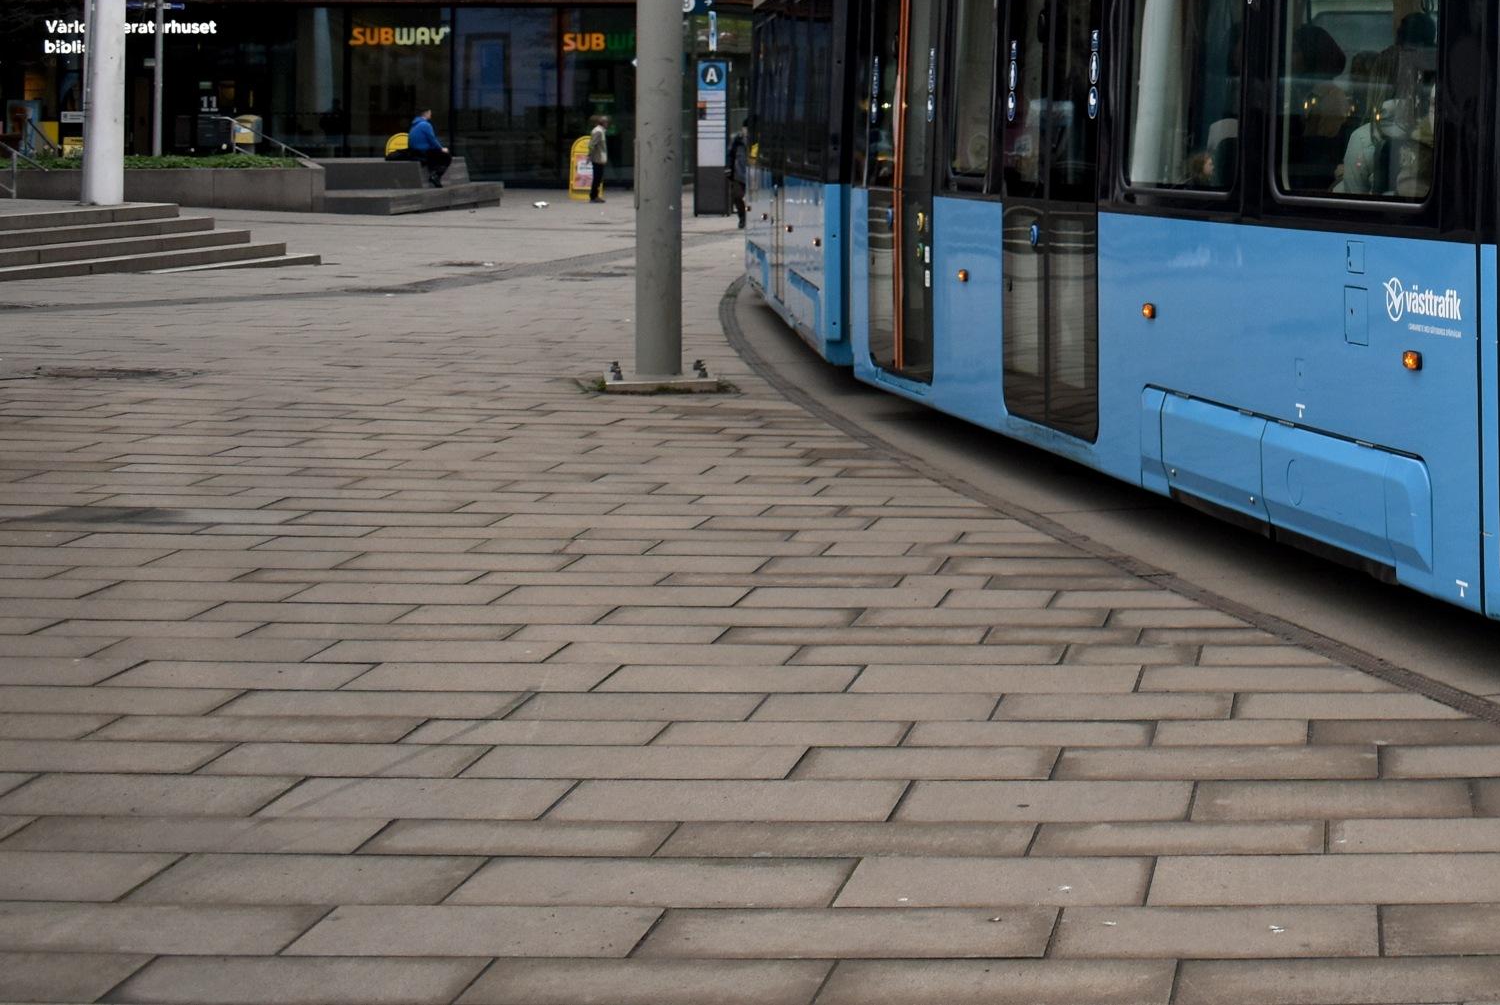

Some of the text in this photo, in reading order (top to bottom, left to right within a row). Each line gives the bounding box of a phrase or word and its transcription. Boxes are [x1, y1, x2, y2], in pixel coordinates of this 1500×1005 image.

[45, 20, 217, 34] Värleratrhuset
[349, 27, 445, 46] SUBWAY
[562, 32, 636, 52] SUBW
[44, 40, 86, 54] bibli
[706, 68, 718, 83] A
[1405, 284, 1462, 321] västtrafik
